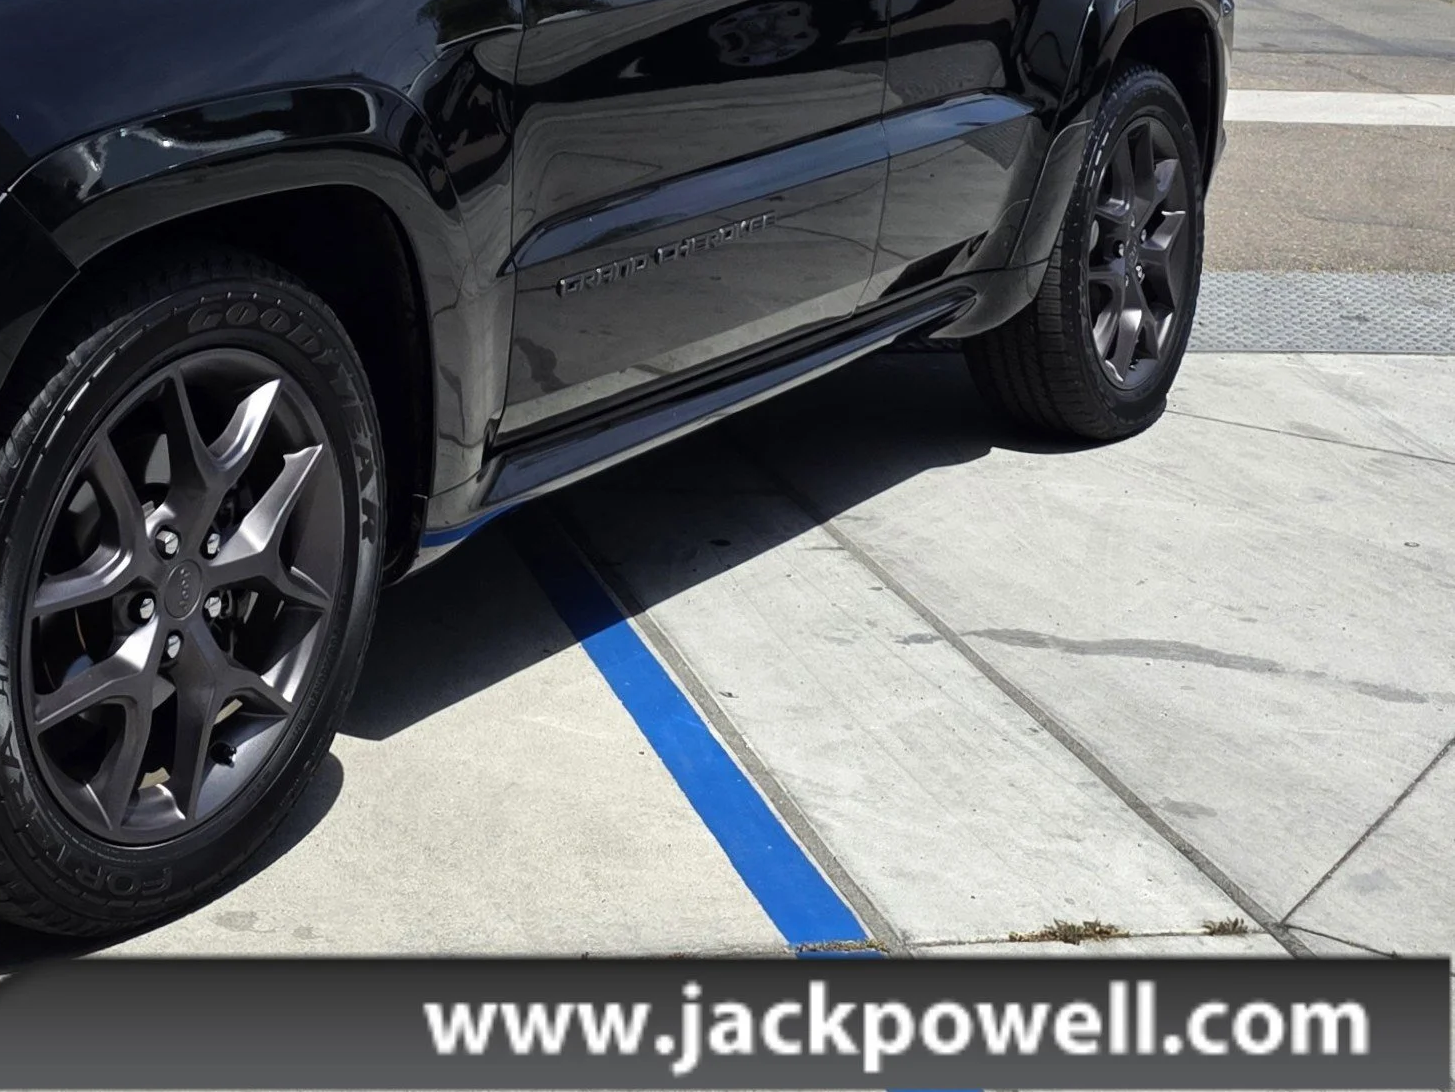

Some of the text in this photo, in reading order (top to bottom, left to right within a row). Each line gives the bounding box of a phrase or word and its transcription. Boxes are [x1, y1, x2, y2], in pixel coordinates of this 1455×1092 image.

[558, 210, 776, 297] GRAND CHEROKEE
[187, 300, 380, 545] GOODYEAR
